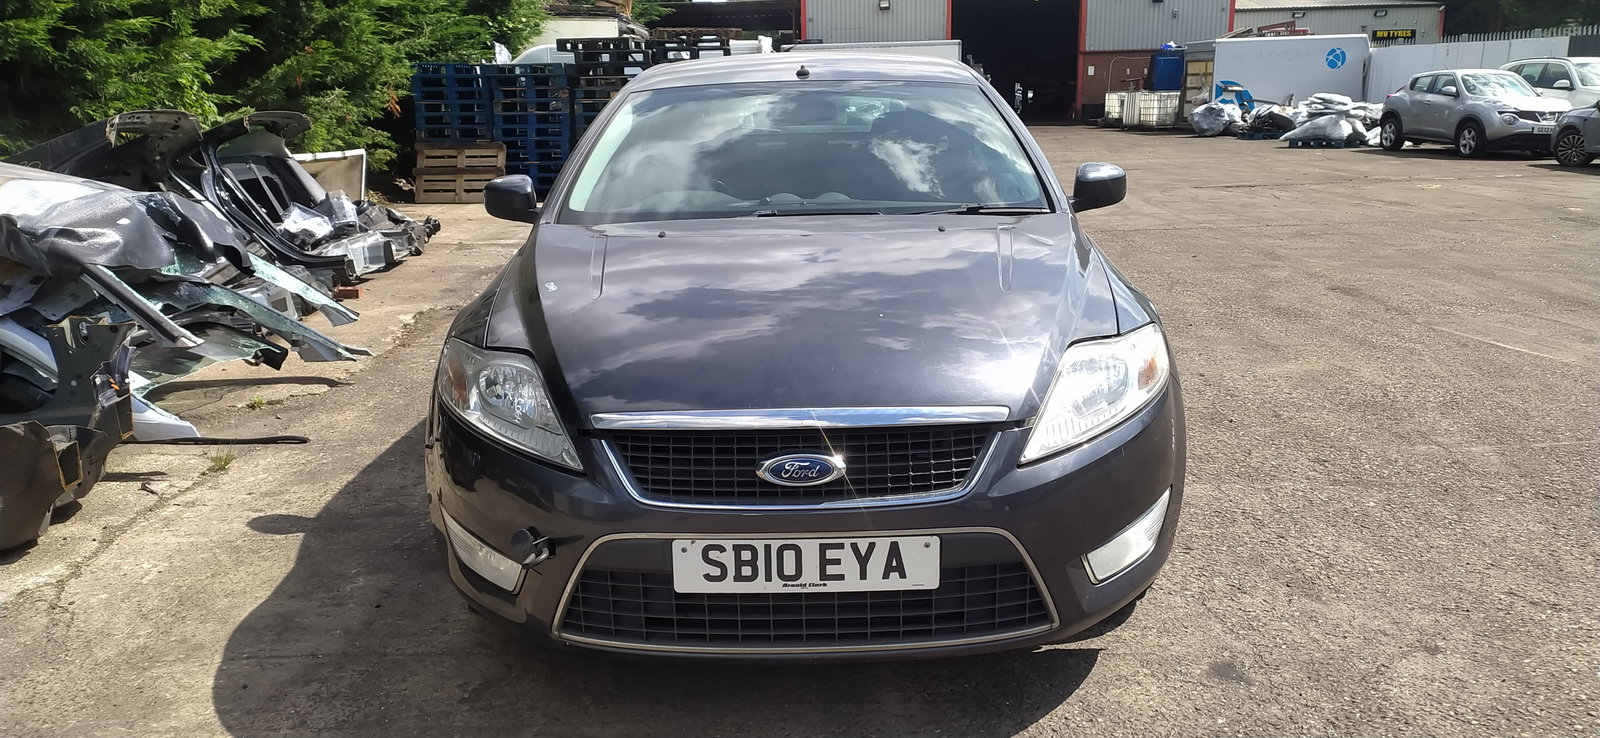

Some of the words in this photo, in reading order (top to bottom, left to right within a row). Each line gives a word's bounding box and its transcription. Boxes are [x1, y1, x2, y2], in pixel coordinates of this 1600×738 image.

[1389, 29, 1412, 37] TYRES
[781, 461, 820, 477] Ford
[701, 543, 803, 582] SB10
[818, 541, 907, 582] EYA
